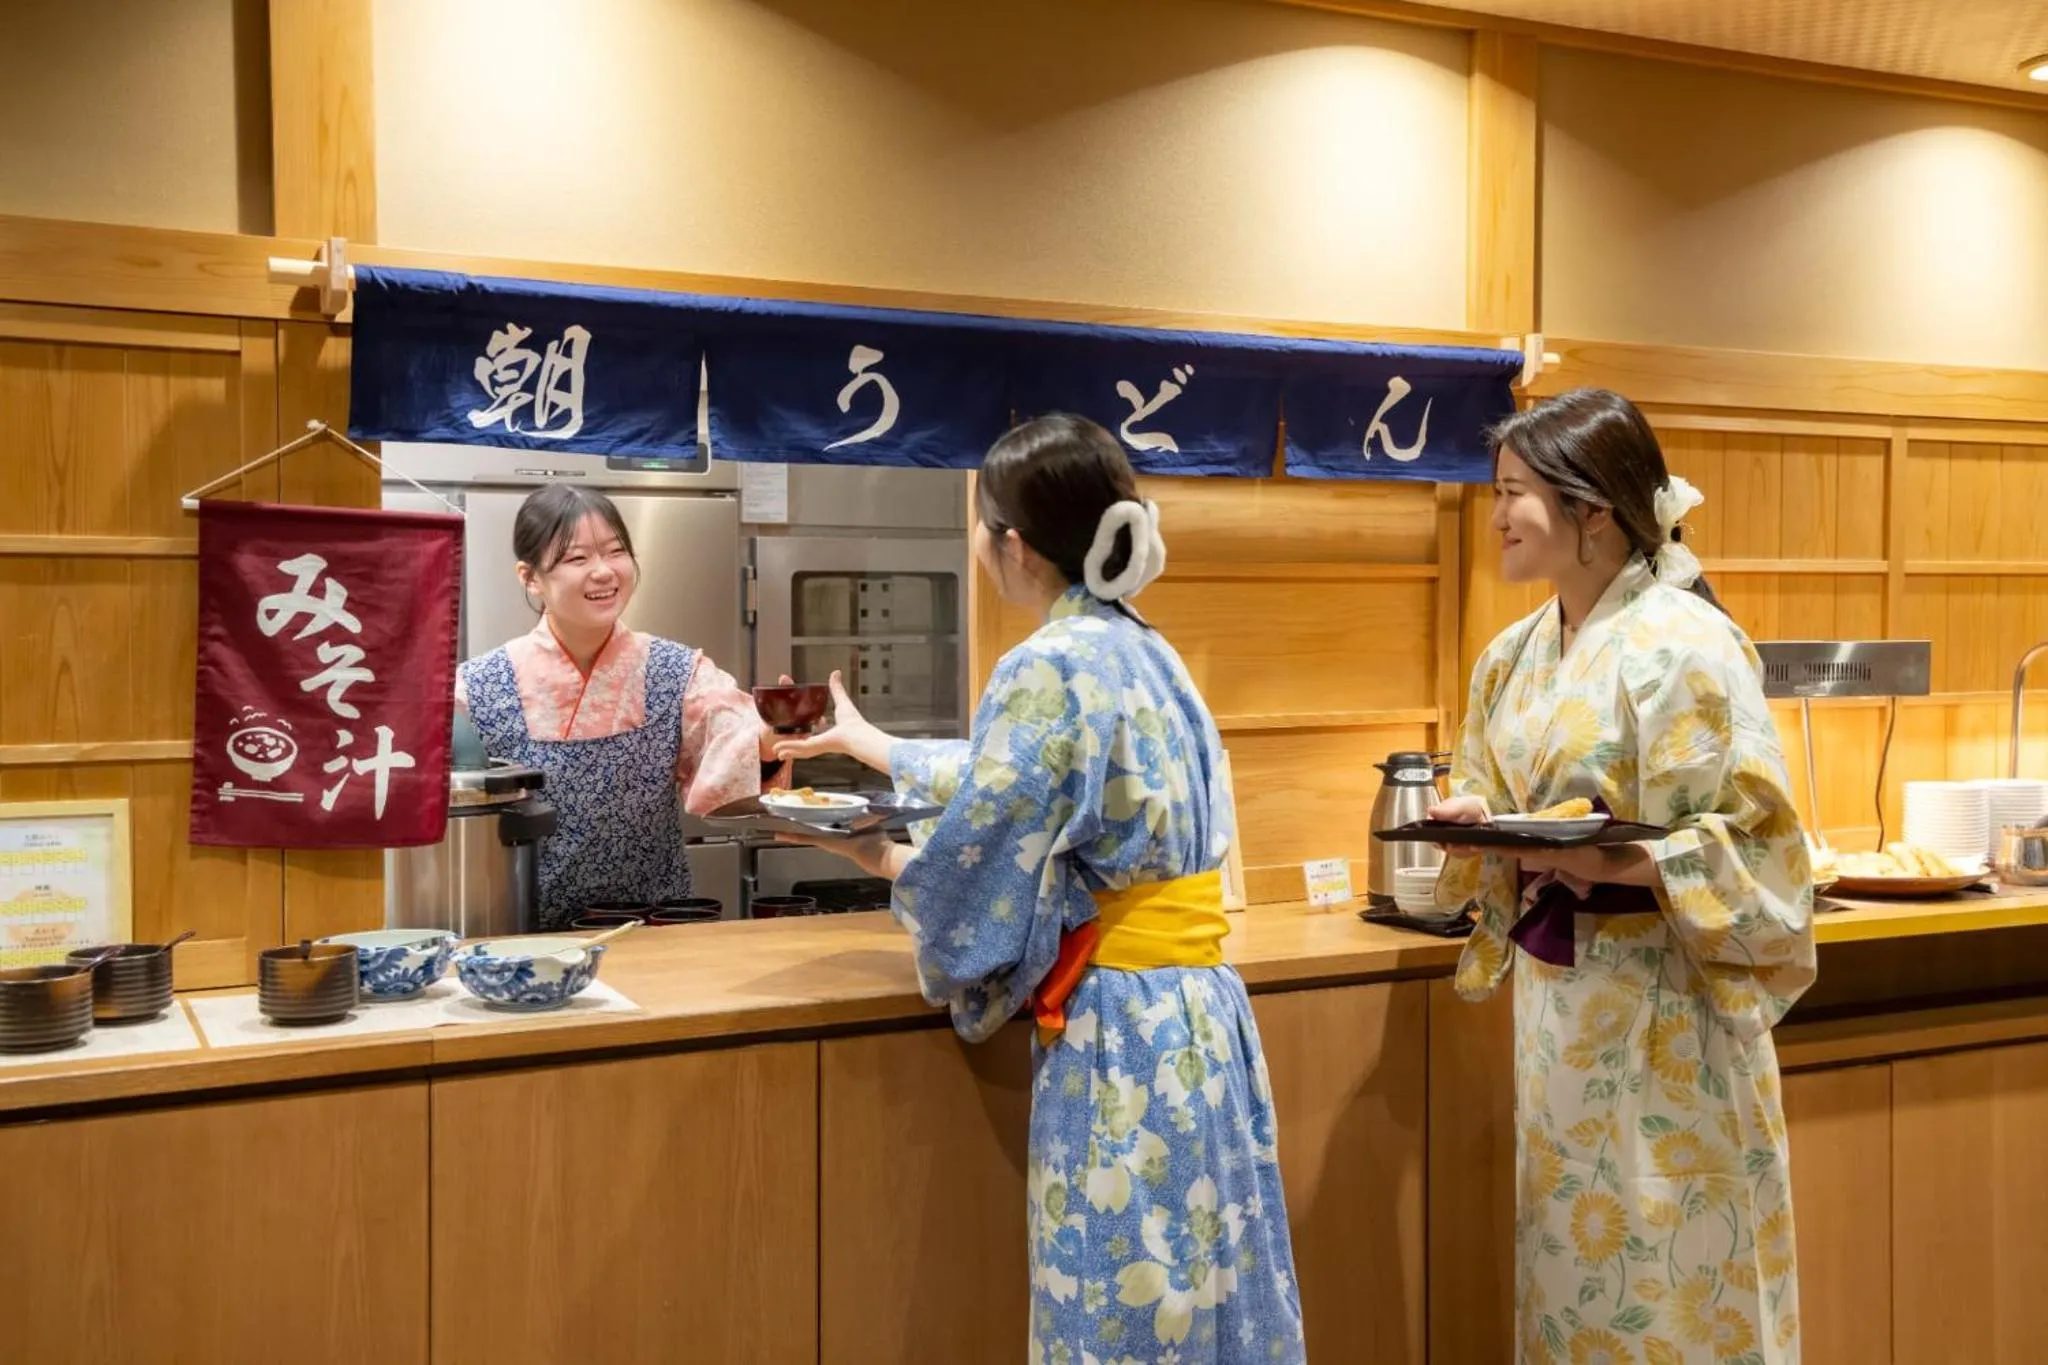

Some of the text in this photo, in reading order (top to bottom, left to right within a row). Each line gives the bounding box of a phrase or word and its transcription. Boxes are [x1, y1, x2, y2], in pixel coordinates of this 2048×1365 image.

[467, 322, 1432, 463] 朝うどん
[257, 553, 416, 821] みそ汁
